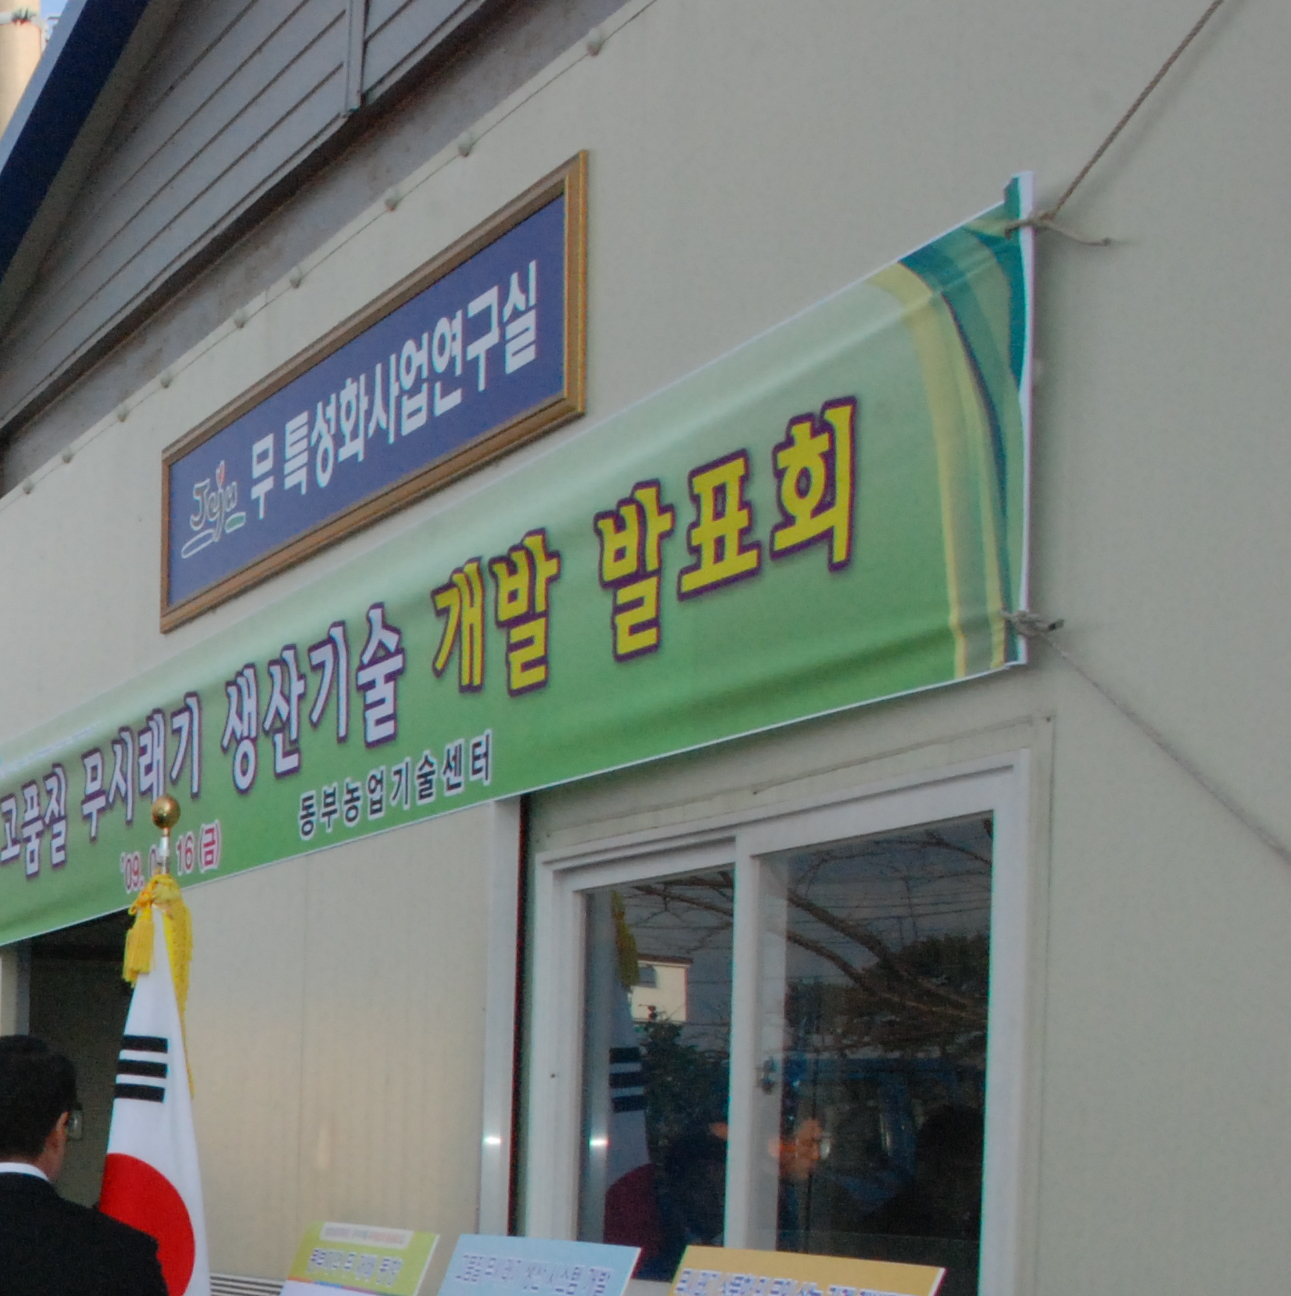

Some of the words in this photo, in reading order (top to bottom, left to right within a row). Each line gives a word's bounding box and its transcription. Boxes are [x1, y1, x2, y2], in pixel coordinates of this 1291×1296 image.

[190, 460, 237, 542] Jeju
[251, 434, 275, 519] 무
[0, 762, 68, 879] 고품질
[80, 691, 202, 842] 무시래기
[222, 602, 406, 794] 생산기술
[432, 527, 560, 696] 개발
[594, 396, 857, 662] 발표회
[297, 729, 493, 842] 동부농업기술센터
[198, 819, 222, 874] (금)
